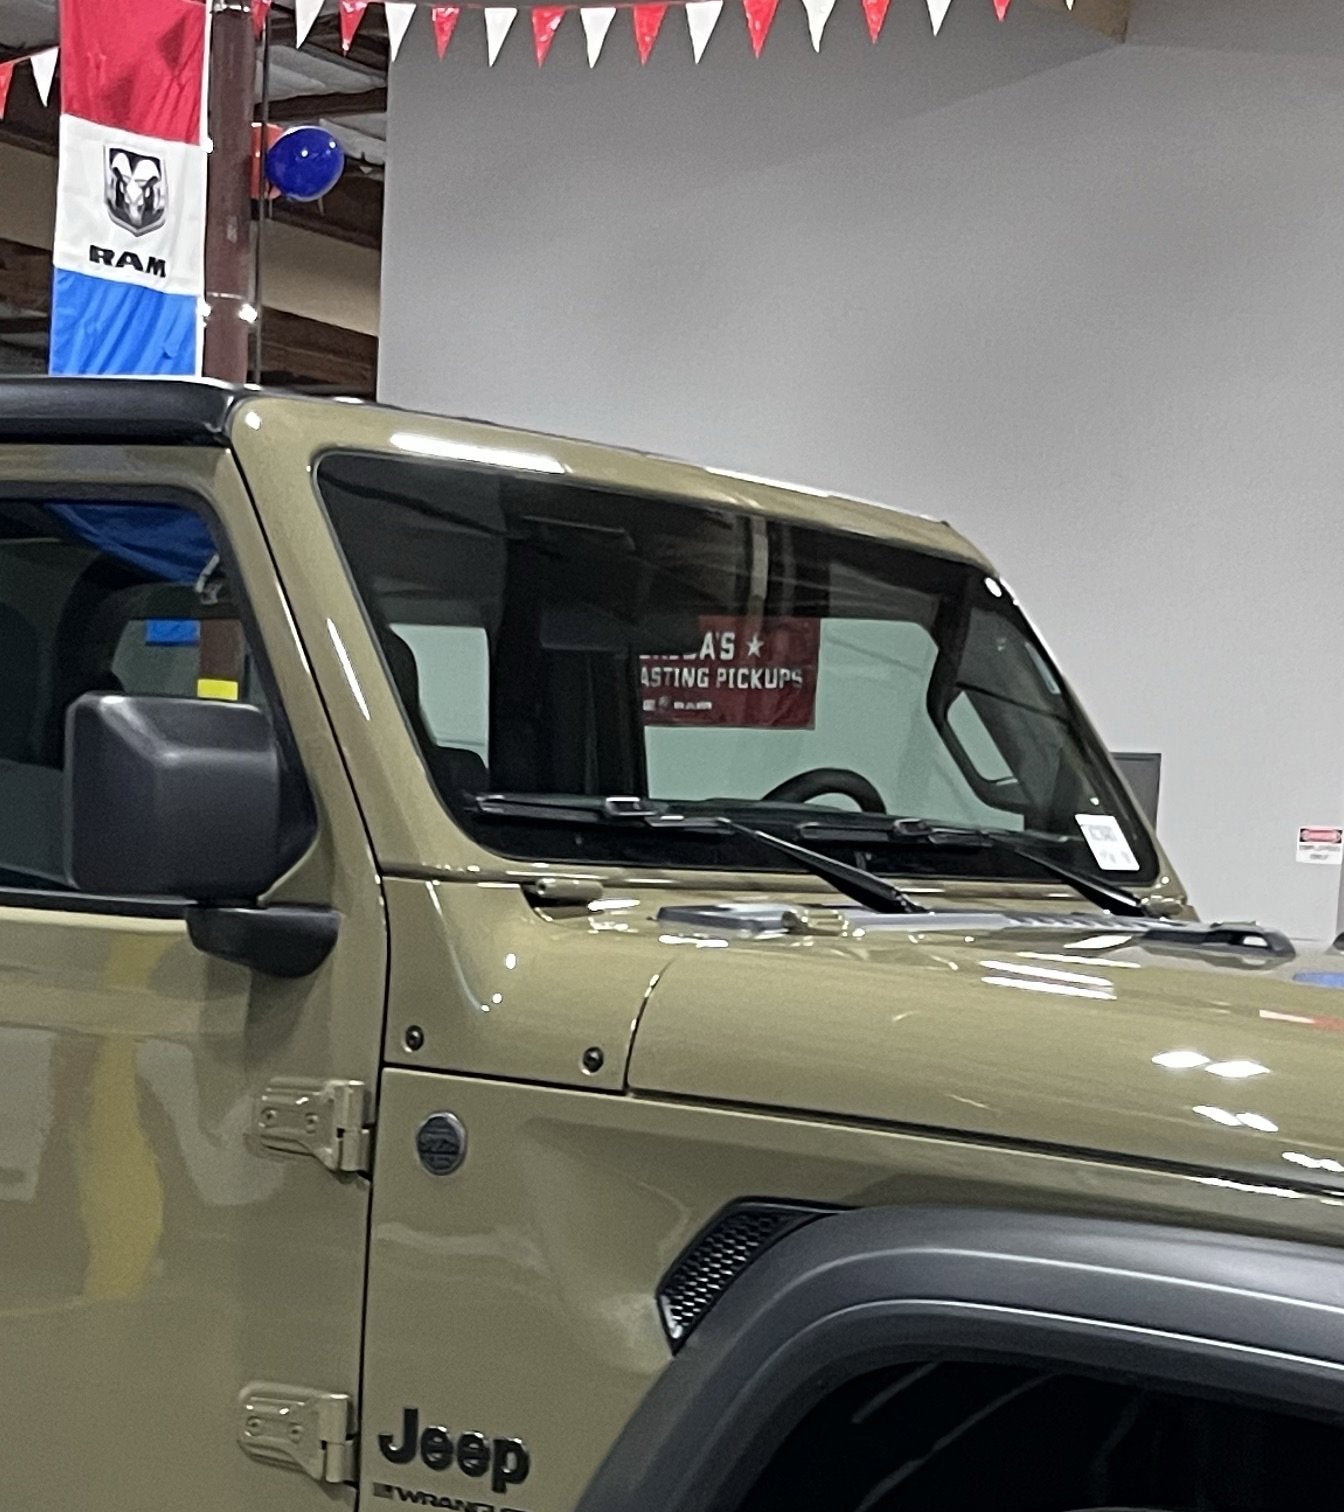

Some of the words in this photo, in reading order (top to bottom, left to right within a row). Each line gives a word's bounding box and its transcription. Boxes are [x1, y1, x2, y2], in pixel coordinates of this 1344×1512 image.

[89, 245, 167, 278] RAM
[640, 667, 709, 688] ASTING
[716, 667, 803, 689] PICKUPS
[377, 1407, 531, 1494] Jeep
